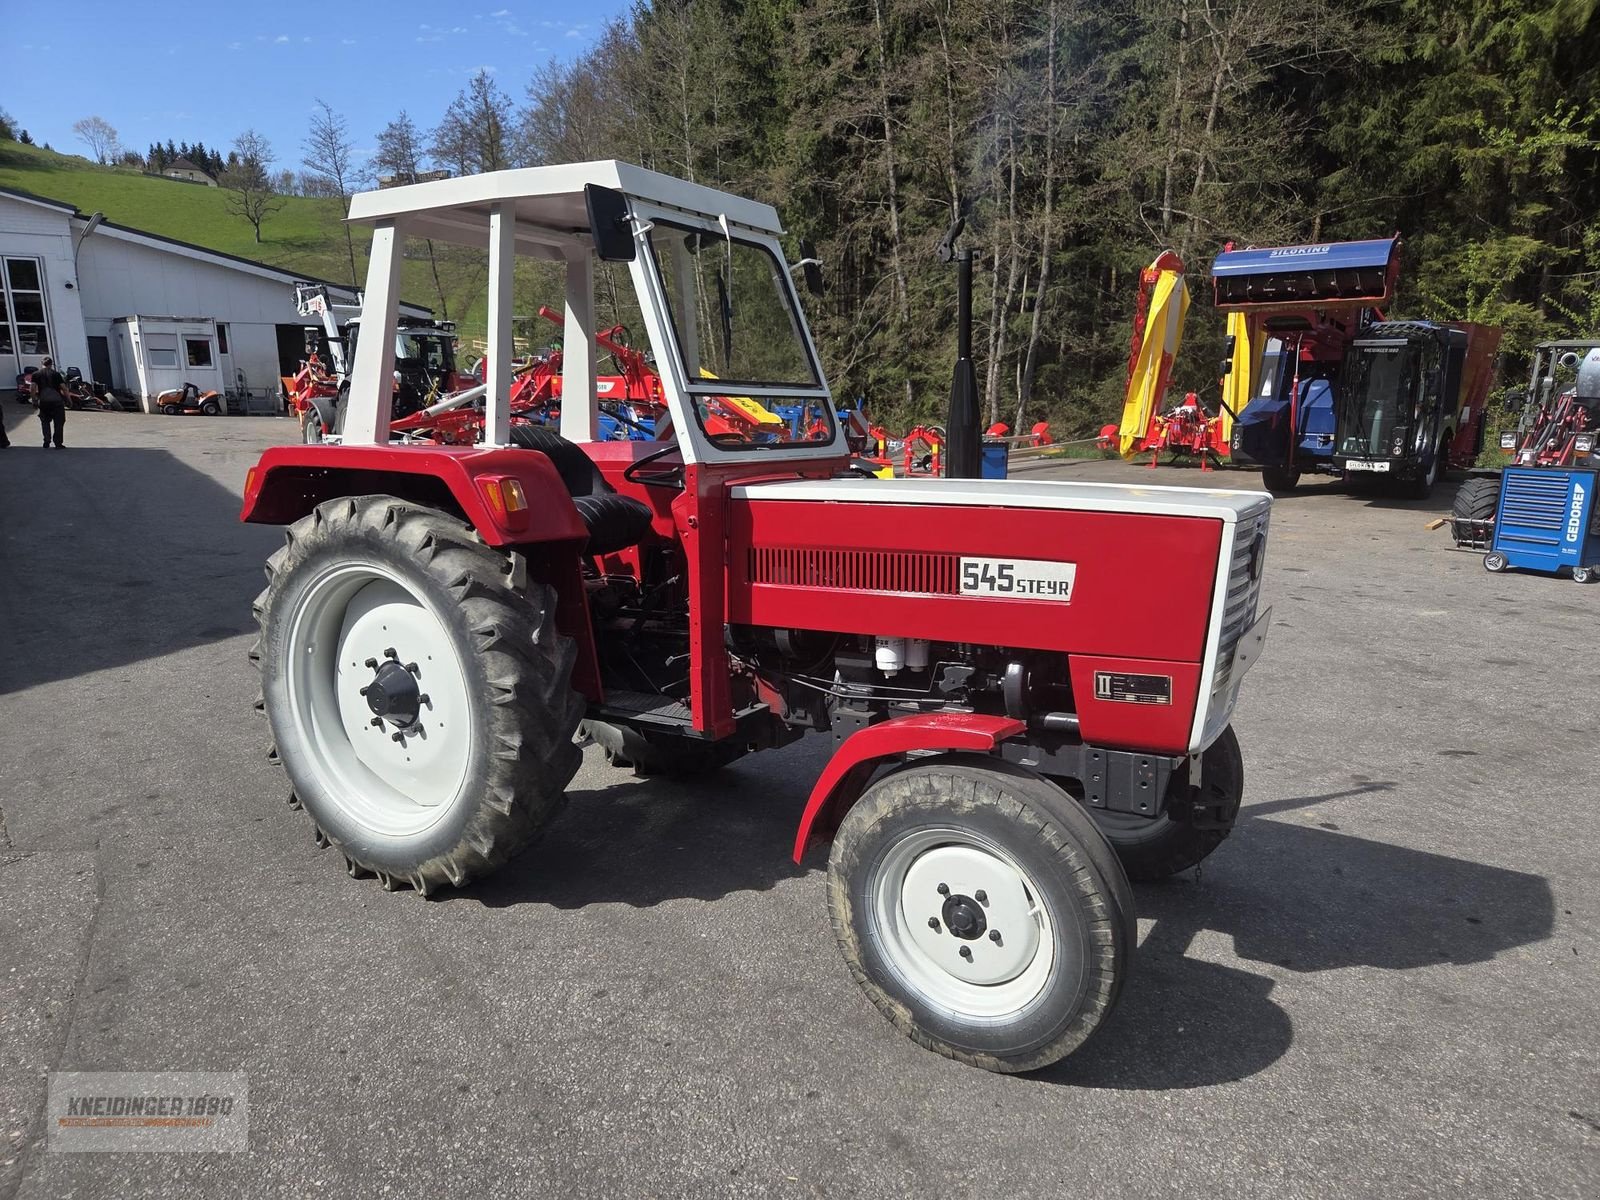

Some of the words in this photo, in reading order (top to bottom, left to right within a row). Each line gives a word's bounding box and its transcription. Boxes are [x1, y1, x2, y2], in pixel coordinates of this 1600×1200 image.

[1270, 247, 1330, 256] SILOKING
[1566, 493, 1585, 542] GEDORE
[963, 563, 1014, 592] 545
[1016, 579, 1069, 595] STEYR
